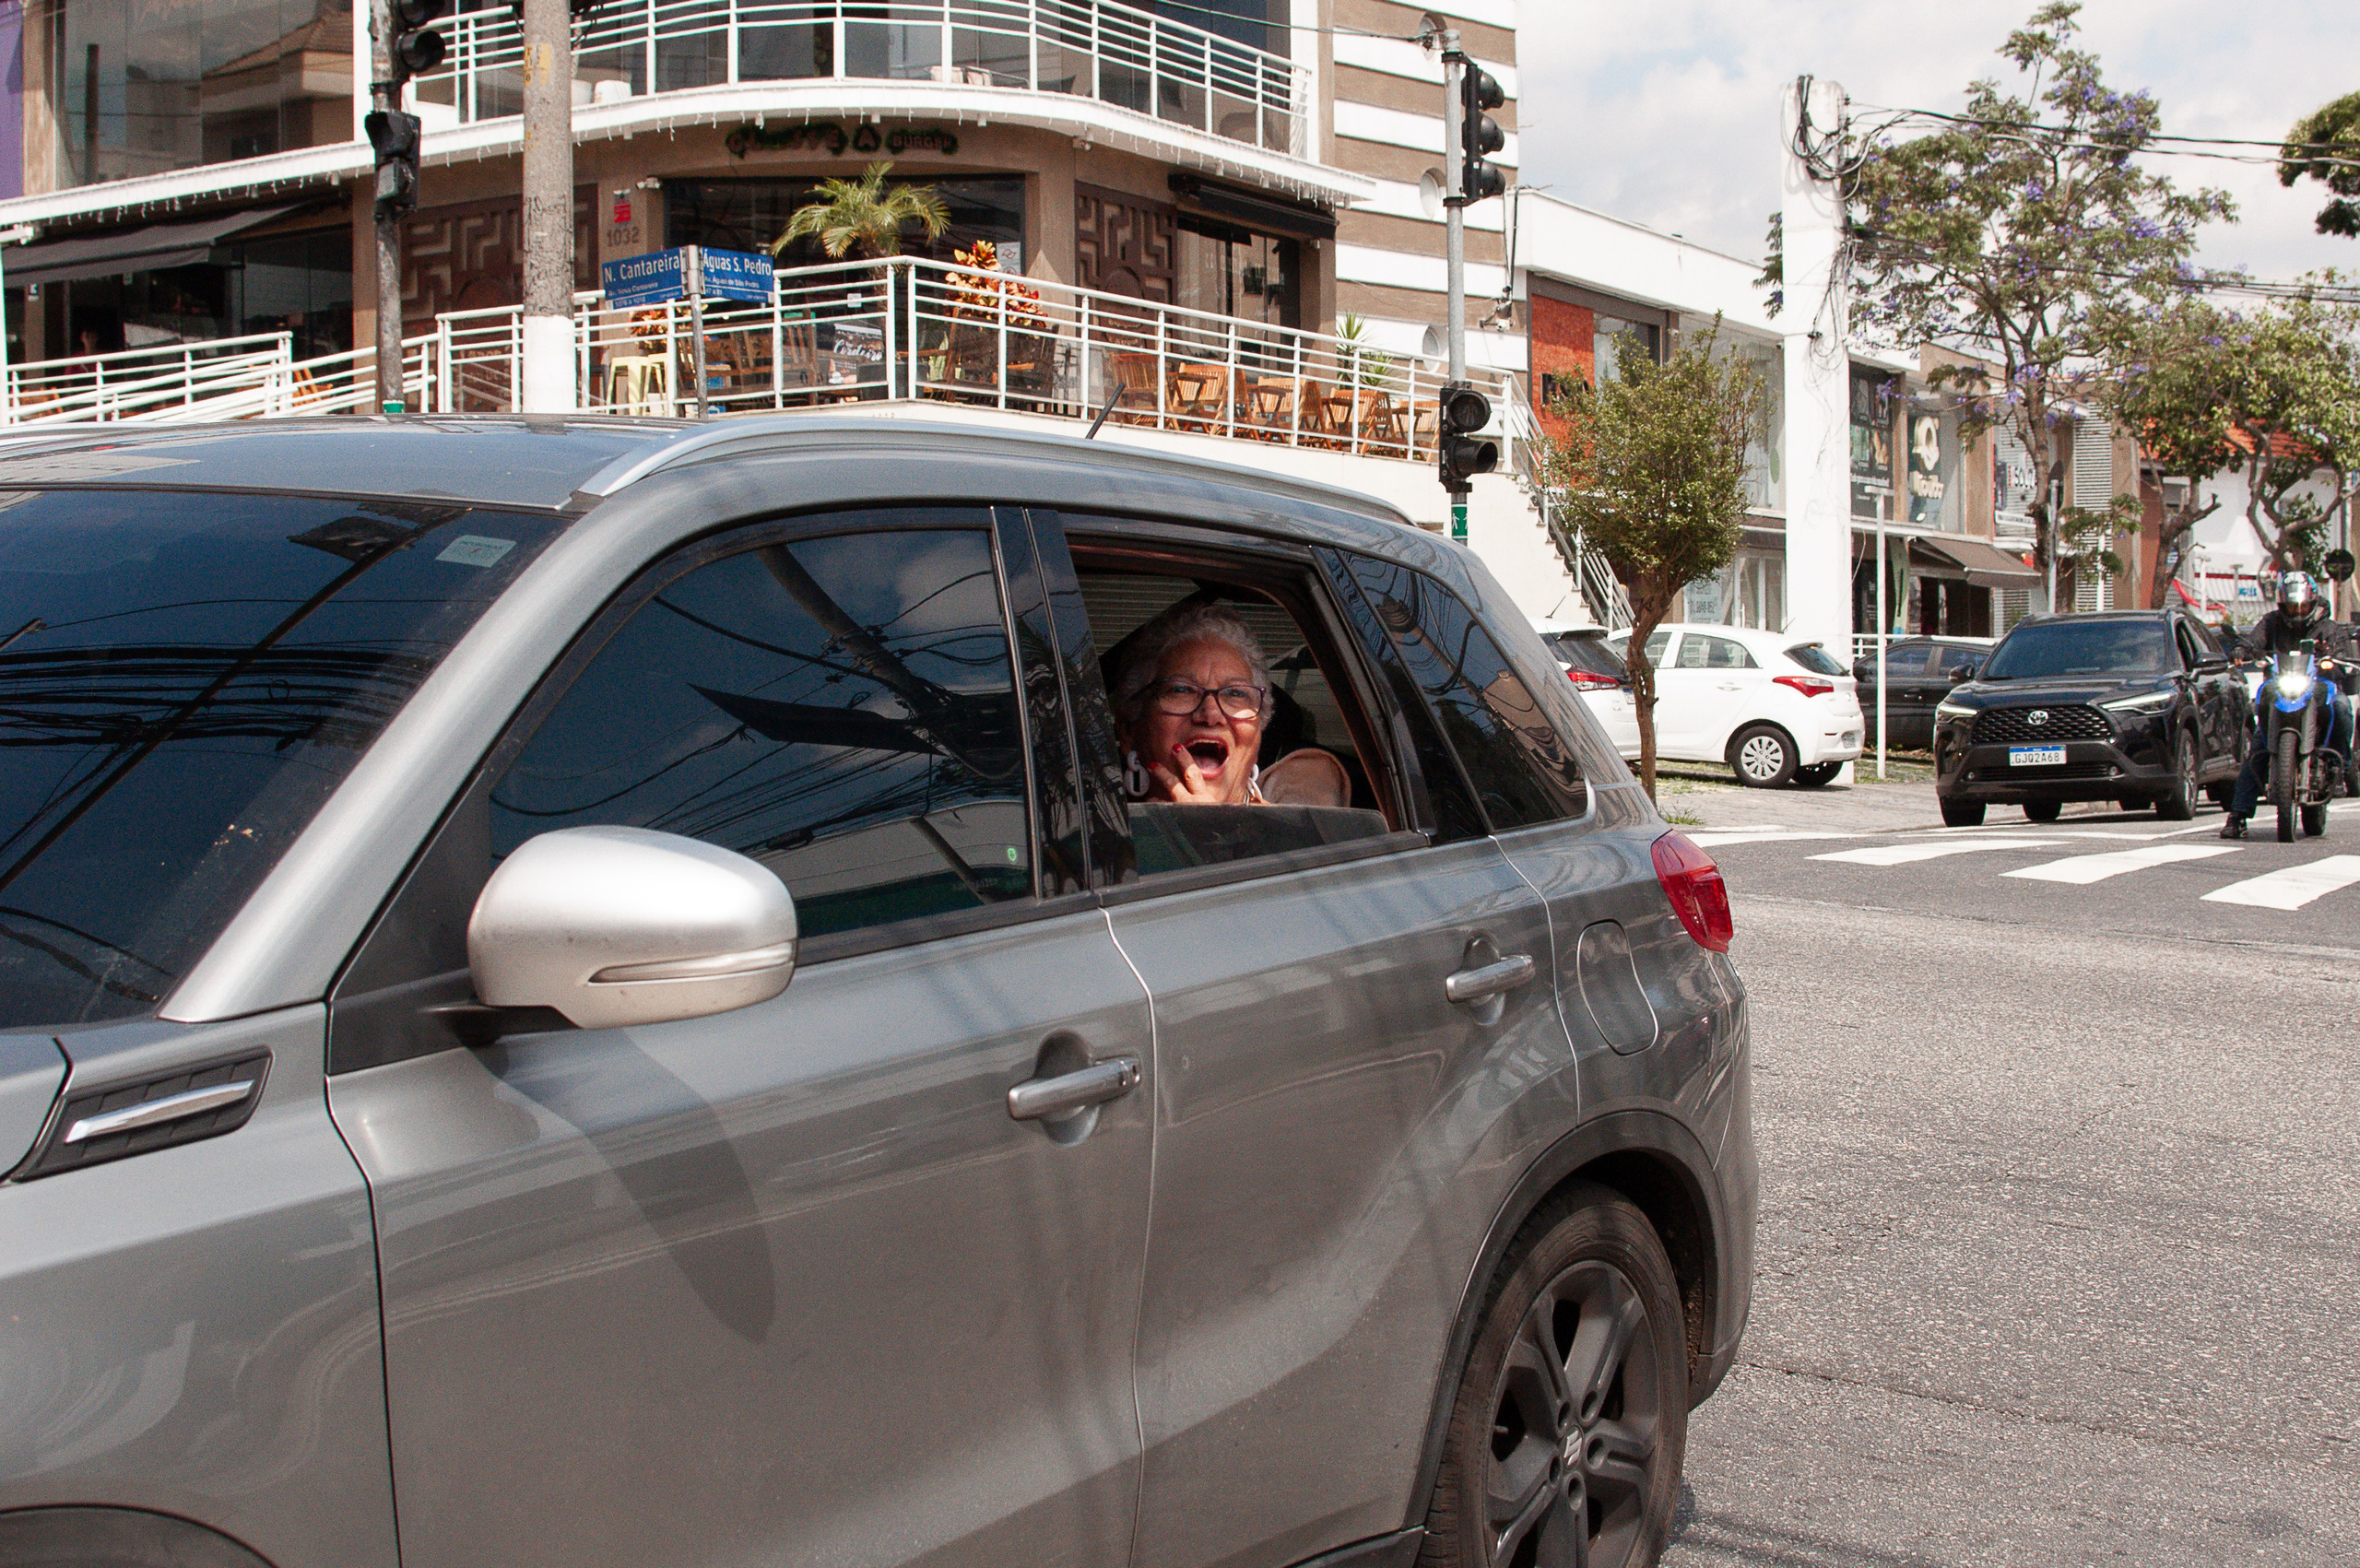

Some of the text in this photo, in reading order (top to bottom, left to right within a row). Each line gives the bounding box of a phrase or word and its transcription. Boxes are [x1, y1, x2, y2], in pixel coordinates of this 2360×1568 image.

[857, 128, 875, 147] A
[891, 134, 952, 149] BURGER
[607, 226, 640, 247] 1032
[604, 253, 680, 284] N. Cantareira
[703, 249, 772, 277] Águas S. Pedro
